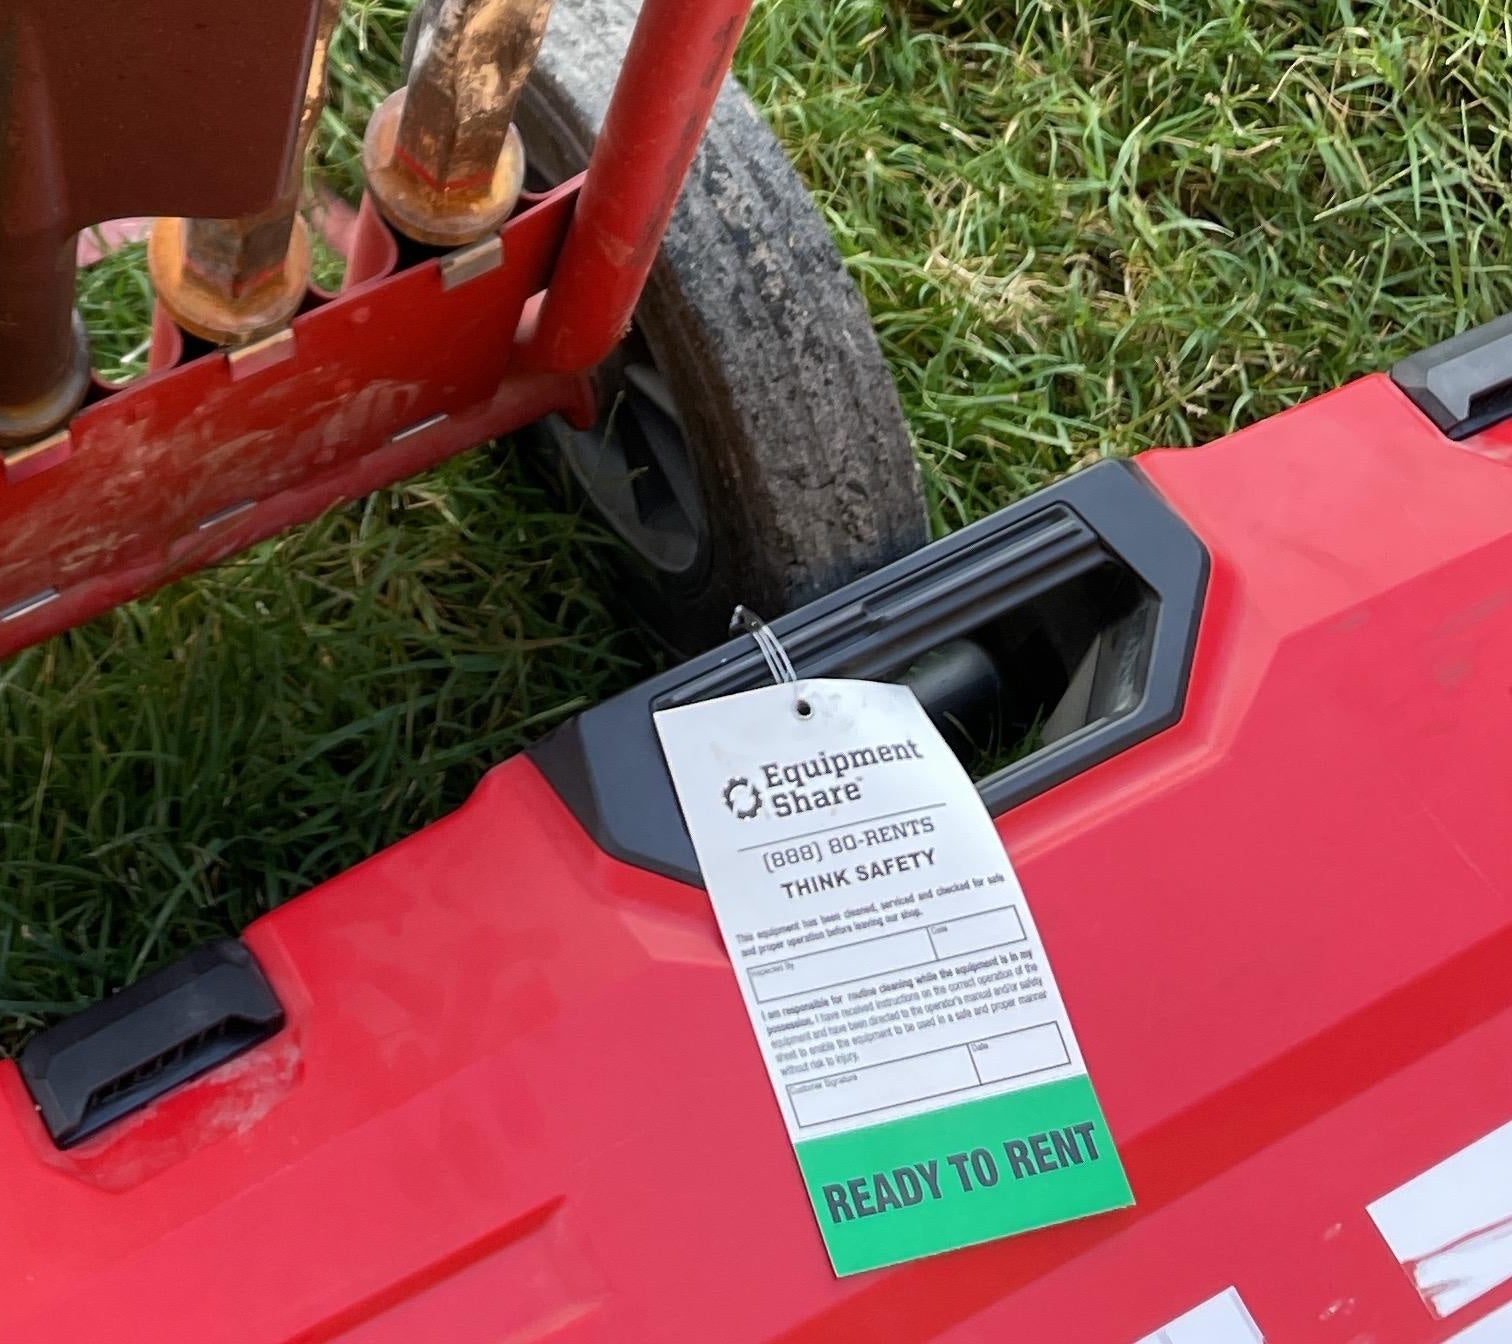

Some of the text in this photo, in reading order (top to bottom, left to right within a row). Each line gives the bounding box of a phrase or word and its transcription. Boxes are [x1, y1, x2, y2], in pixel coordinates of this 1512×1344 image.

[761, 740, 923, 787] Equipment
[773, 780, 860, 818] Share
[763, 816, 935, 874] (888) 80-RENTS
[780, 848, 935, 900] THINK SAFETY
[736, 872, 1004, 944] This equipment has been cleaned, serviced and checked for safe
[761, 950, 1032, 1021] I am responsible for routine cleaning while the equipment is in my
[823, 1123, 1100, 1223] READY TO RENT
